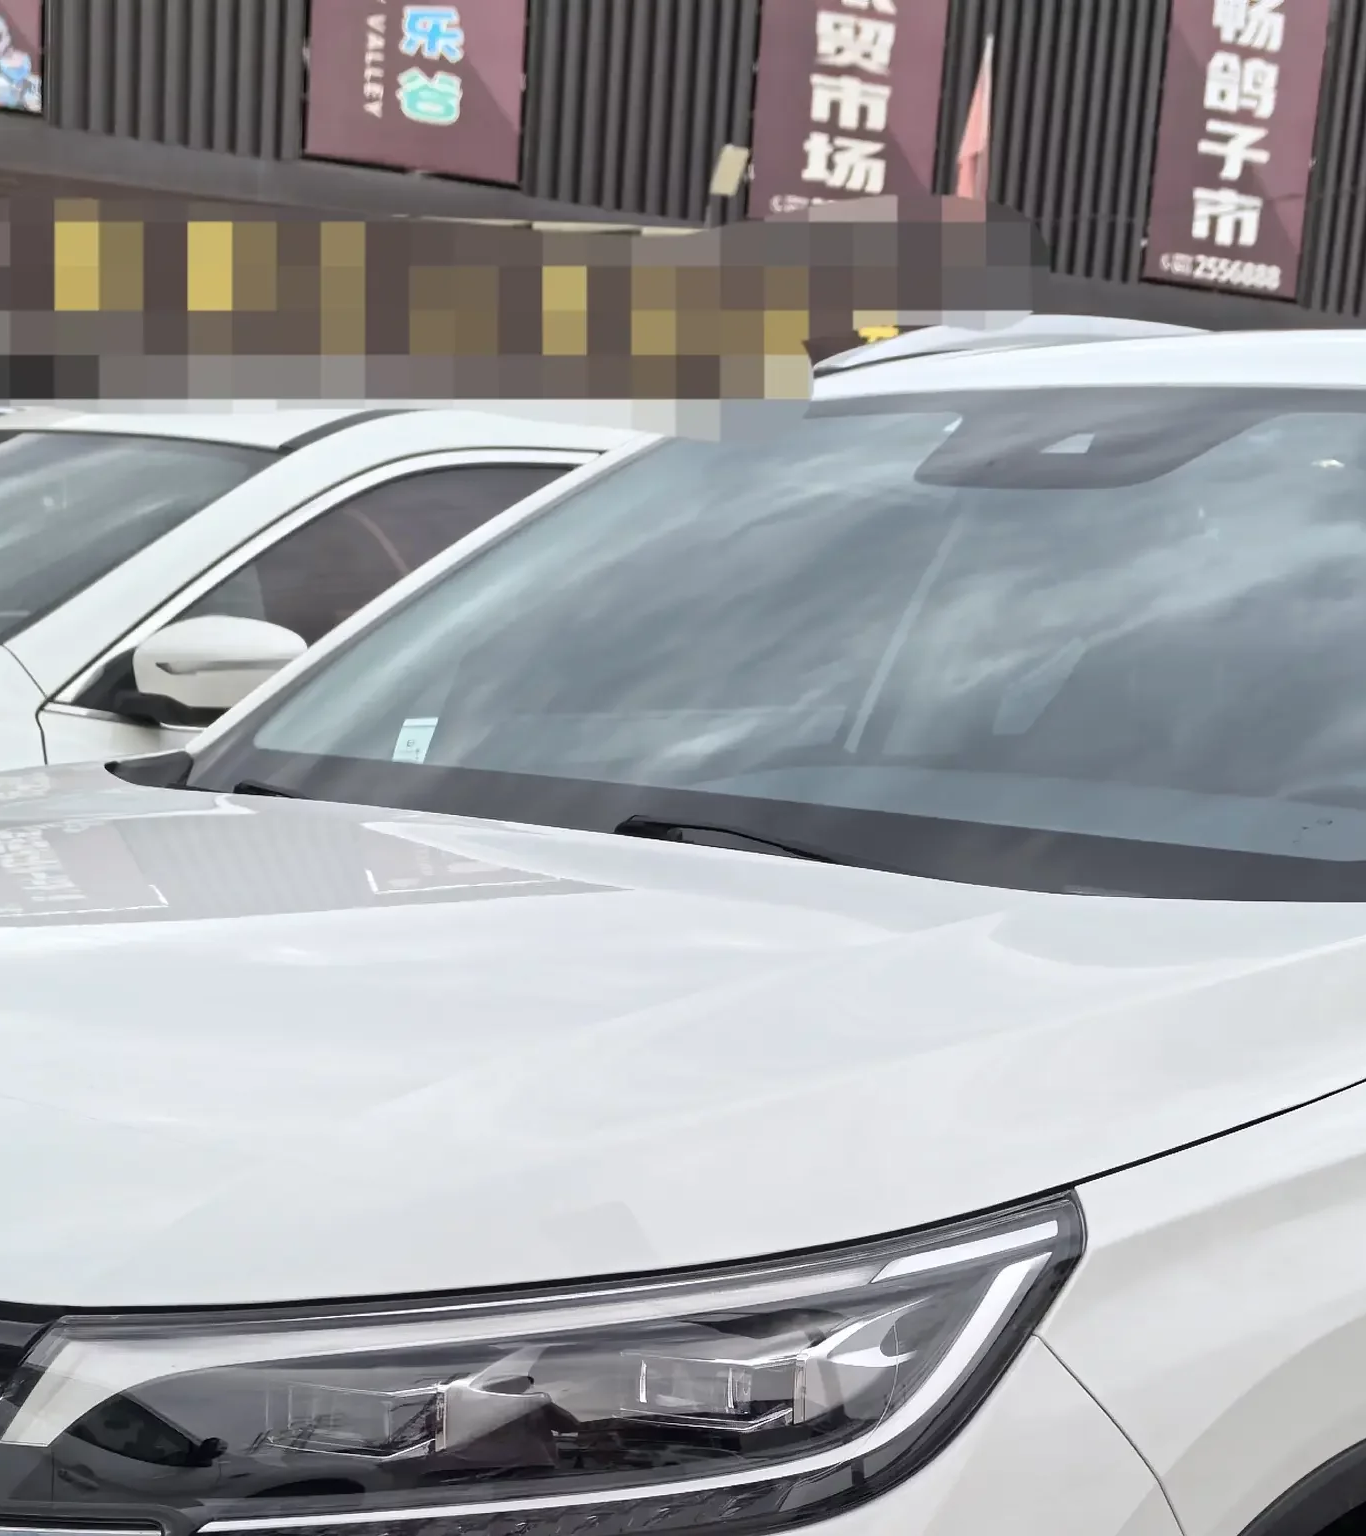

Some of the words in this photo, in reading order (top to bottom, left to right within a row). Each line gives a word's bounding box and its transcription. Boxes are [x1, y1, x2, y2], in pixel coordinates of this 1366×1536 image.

[363, 14, 387, 119] VALLEY
[396, 5, 465, 125] 乐谷
[801, 0, 897, 194] 贸市场
